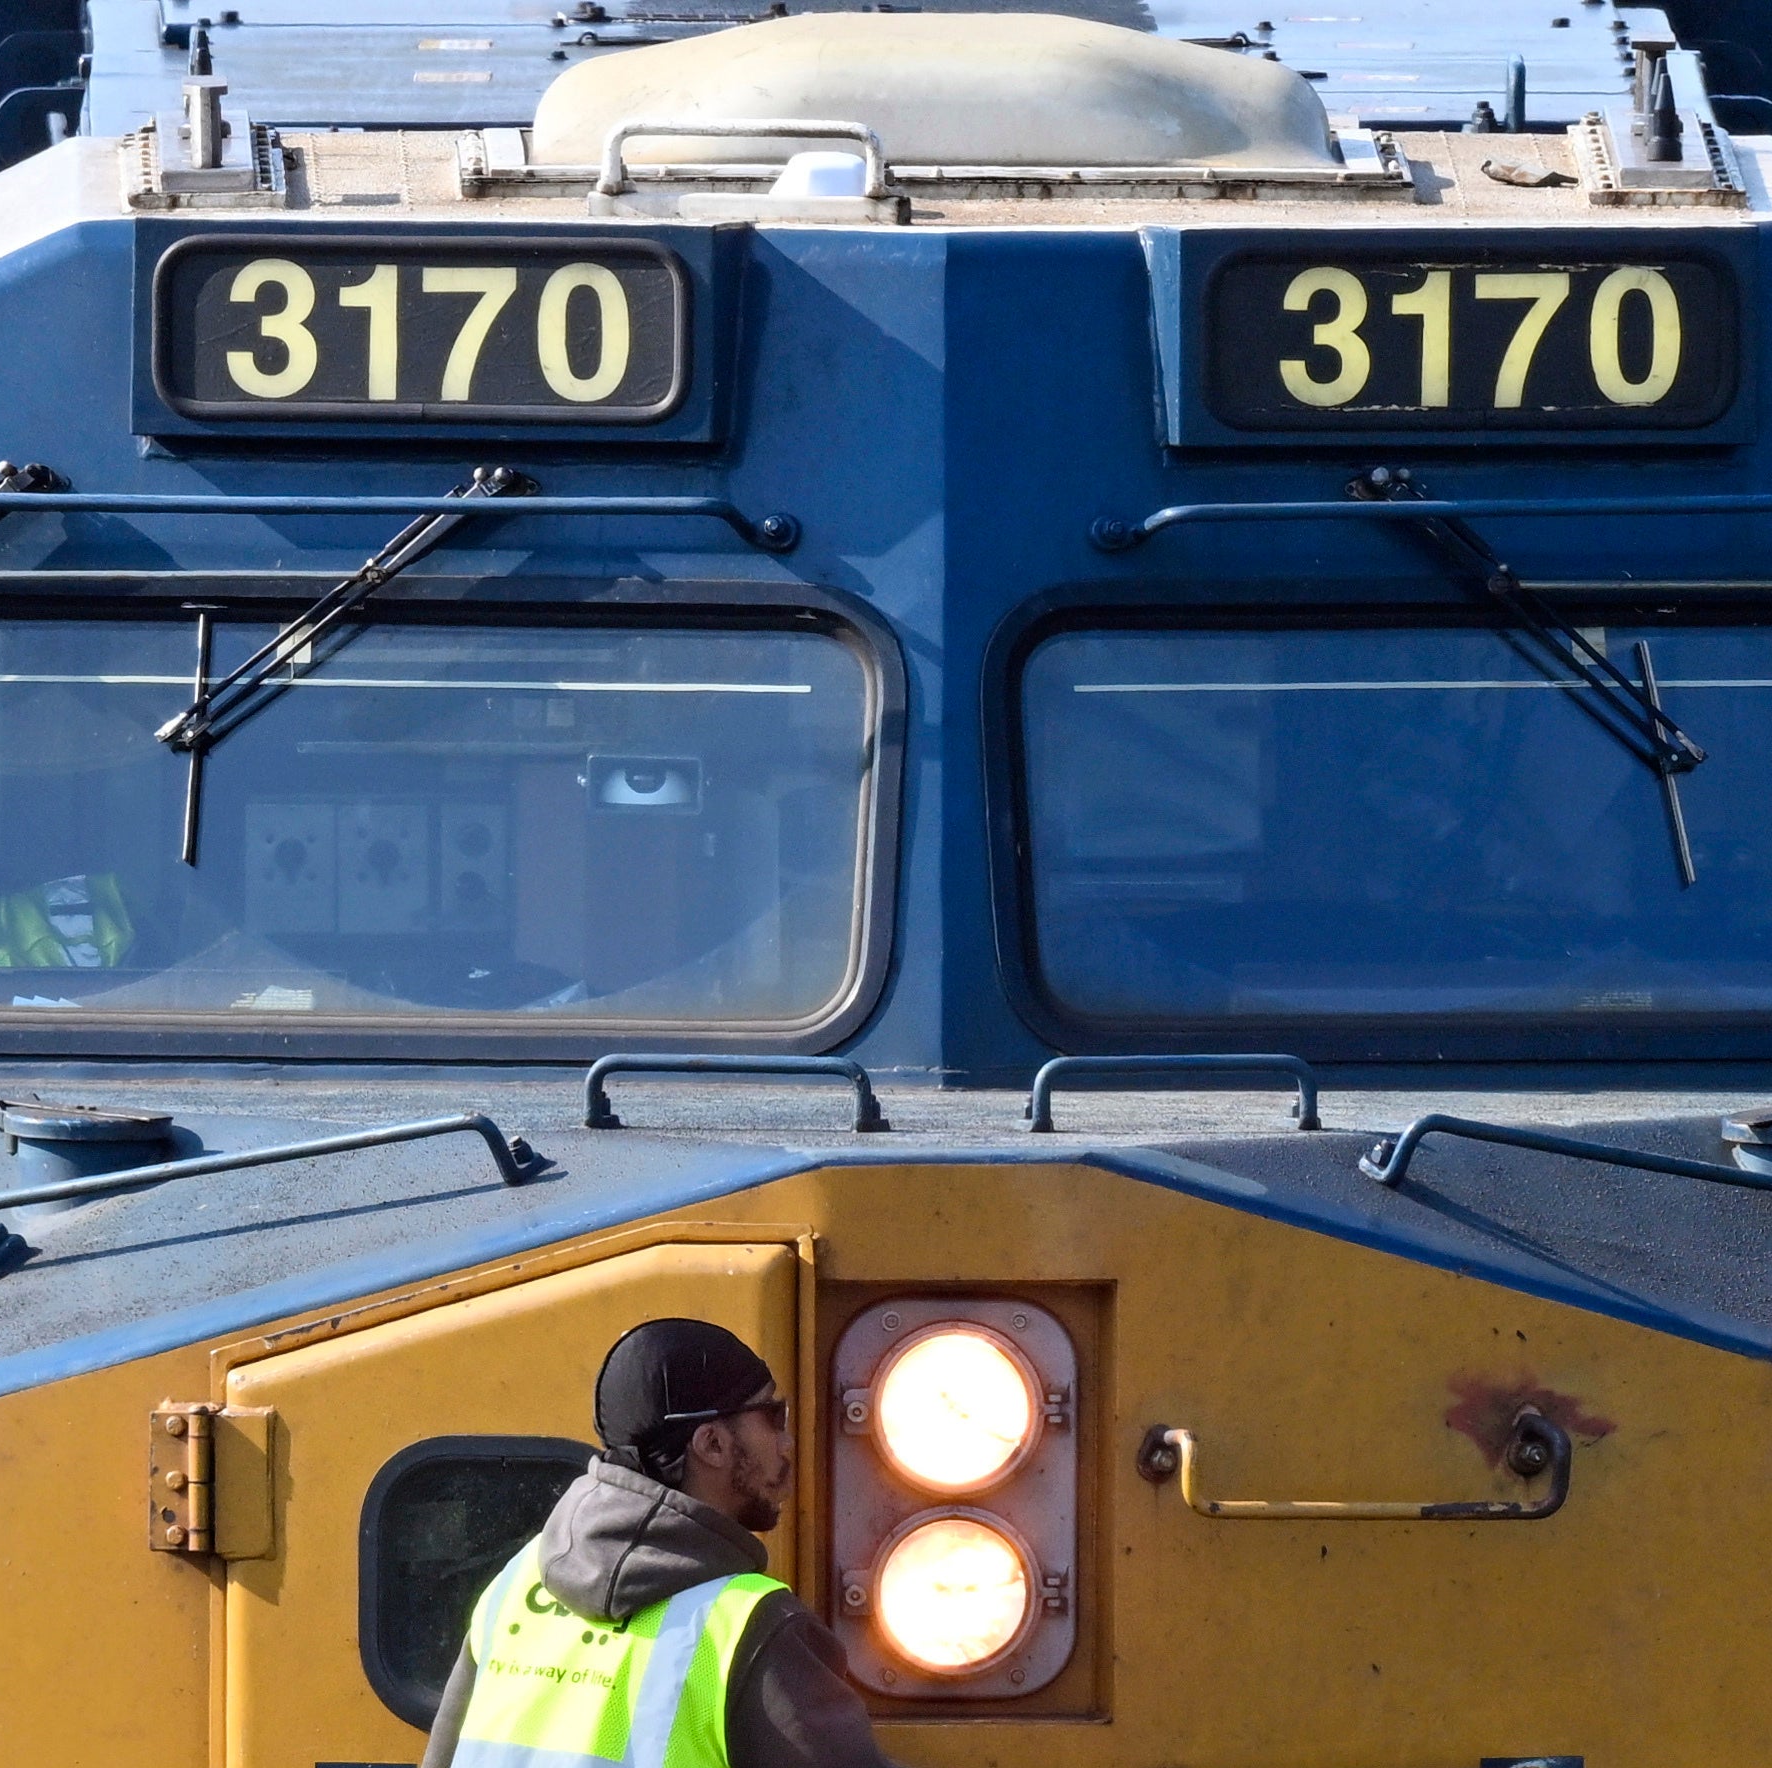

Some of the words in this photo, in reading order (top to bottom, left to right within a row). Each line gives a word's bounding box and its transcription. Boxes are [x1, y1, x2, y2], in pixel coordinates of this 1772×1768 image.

[227, 258, 629, 402] 3170
[1280, 266, 1681, 407] 3170
[534, 1666, 566, 1683] way
[571, 1668, 588, 1684] of
